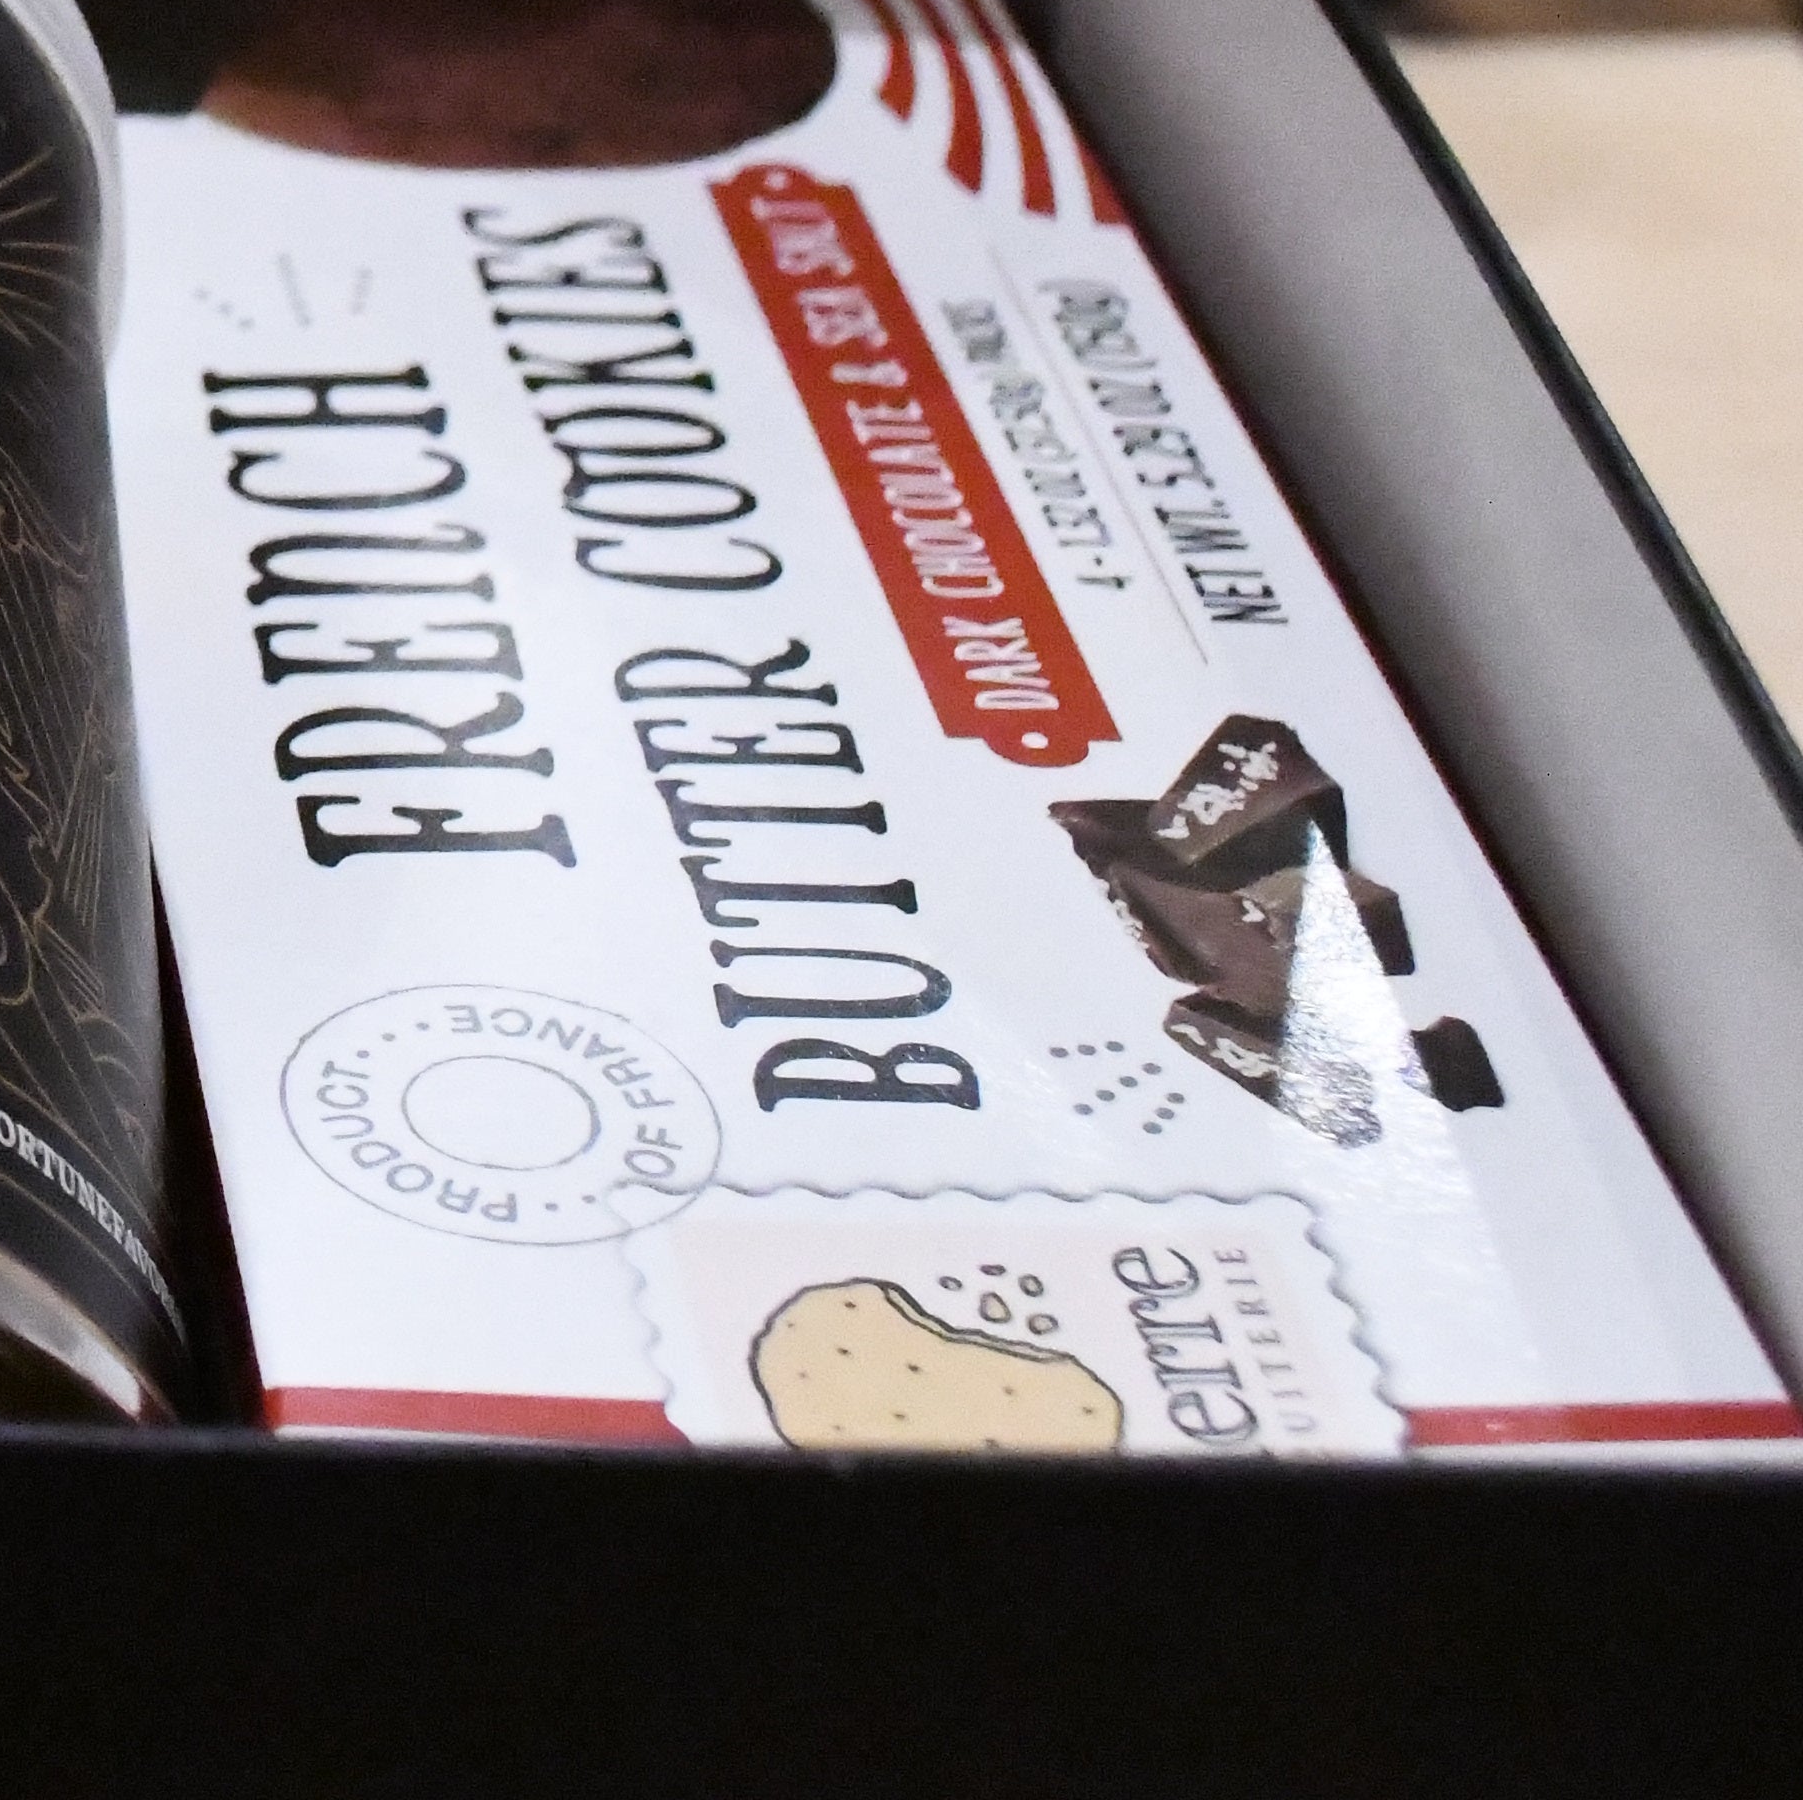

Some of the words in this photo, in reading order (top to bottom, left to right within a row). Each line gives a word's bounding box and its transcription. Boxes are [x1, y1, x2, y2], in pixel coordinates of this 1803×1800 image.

[459, 204, 785, 593] COOKIES
[846, 399, 1006, 599] CHOCOLATE
[201, 363, 578, 870] FRENCH
[942, 615, 1061, 711] DARK
[1184, 562, 1290, 625] NET
[613, 636, 983, 1113] BUTTER
[315, 1058, 519, 1224] PRODUCT
[443, 1003, 676, 1111] FRANCE
[623, 1123, 684, 1179] OF
[1111, 1246, 1261, 1448] erre
